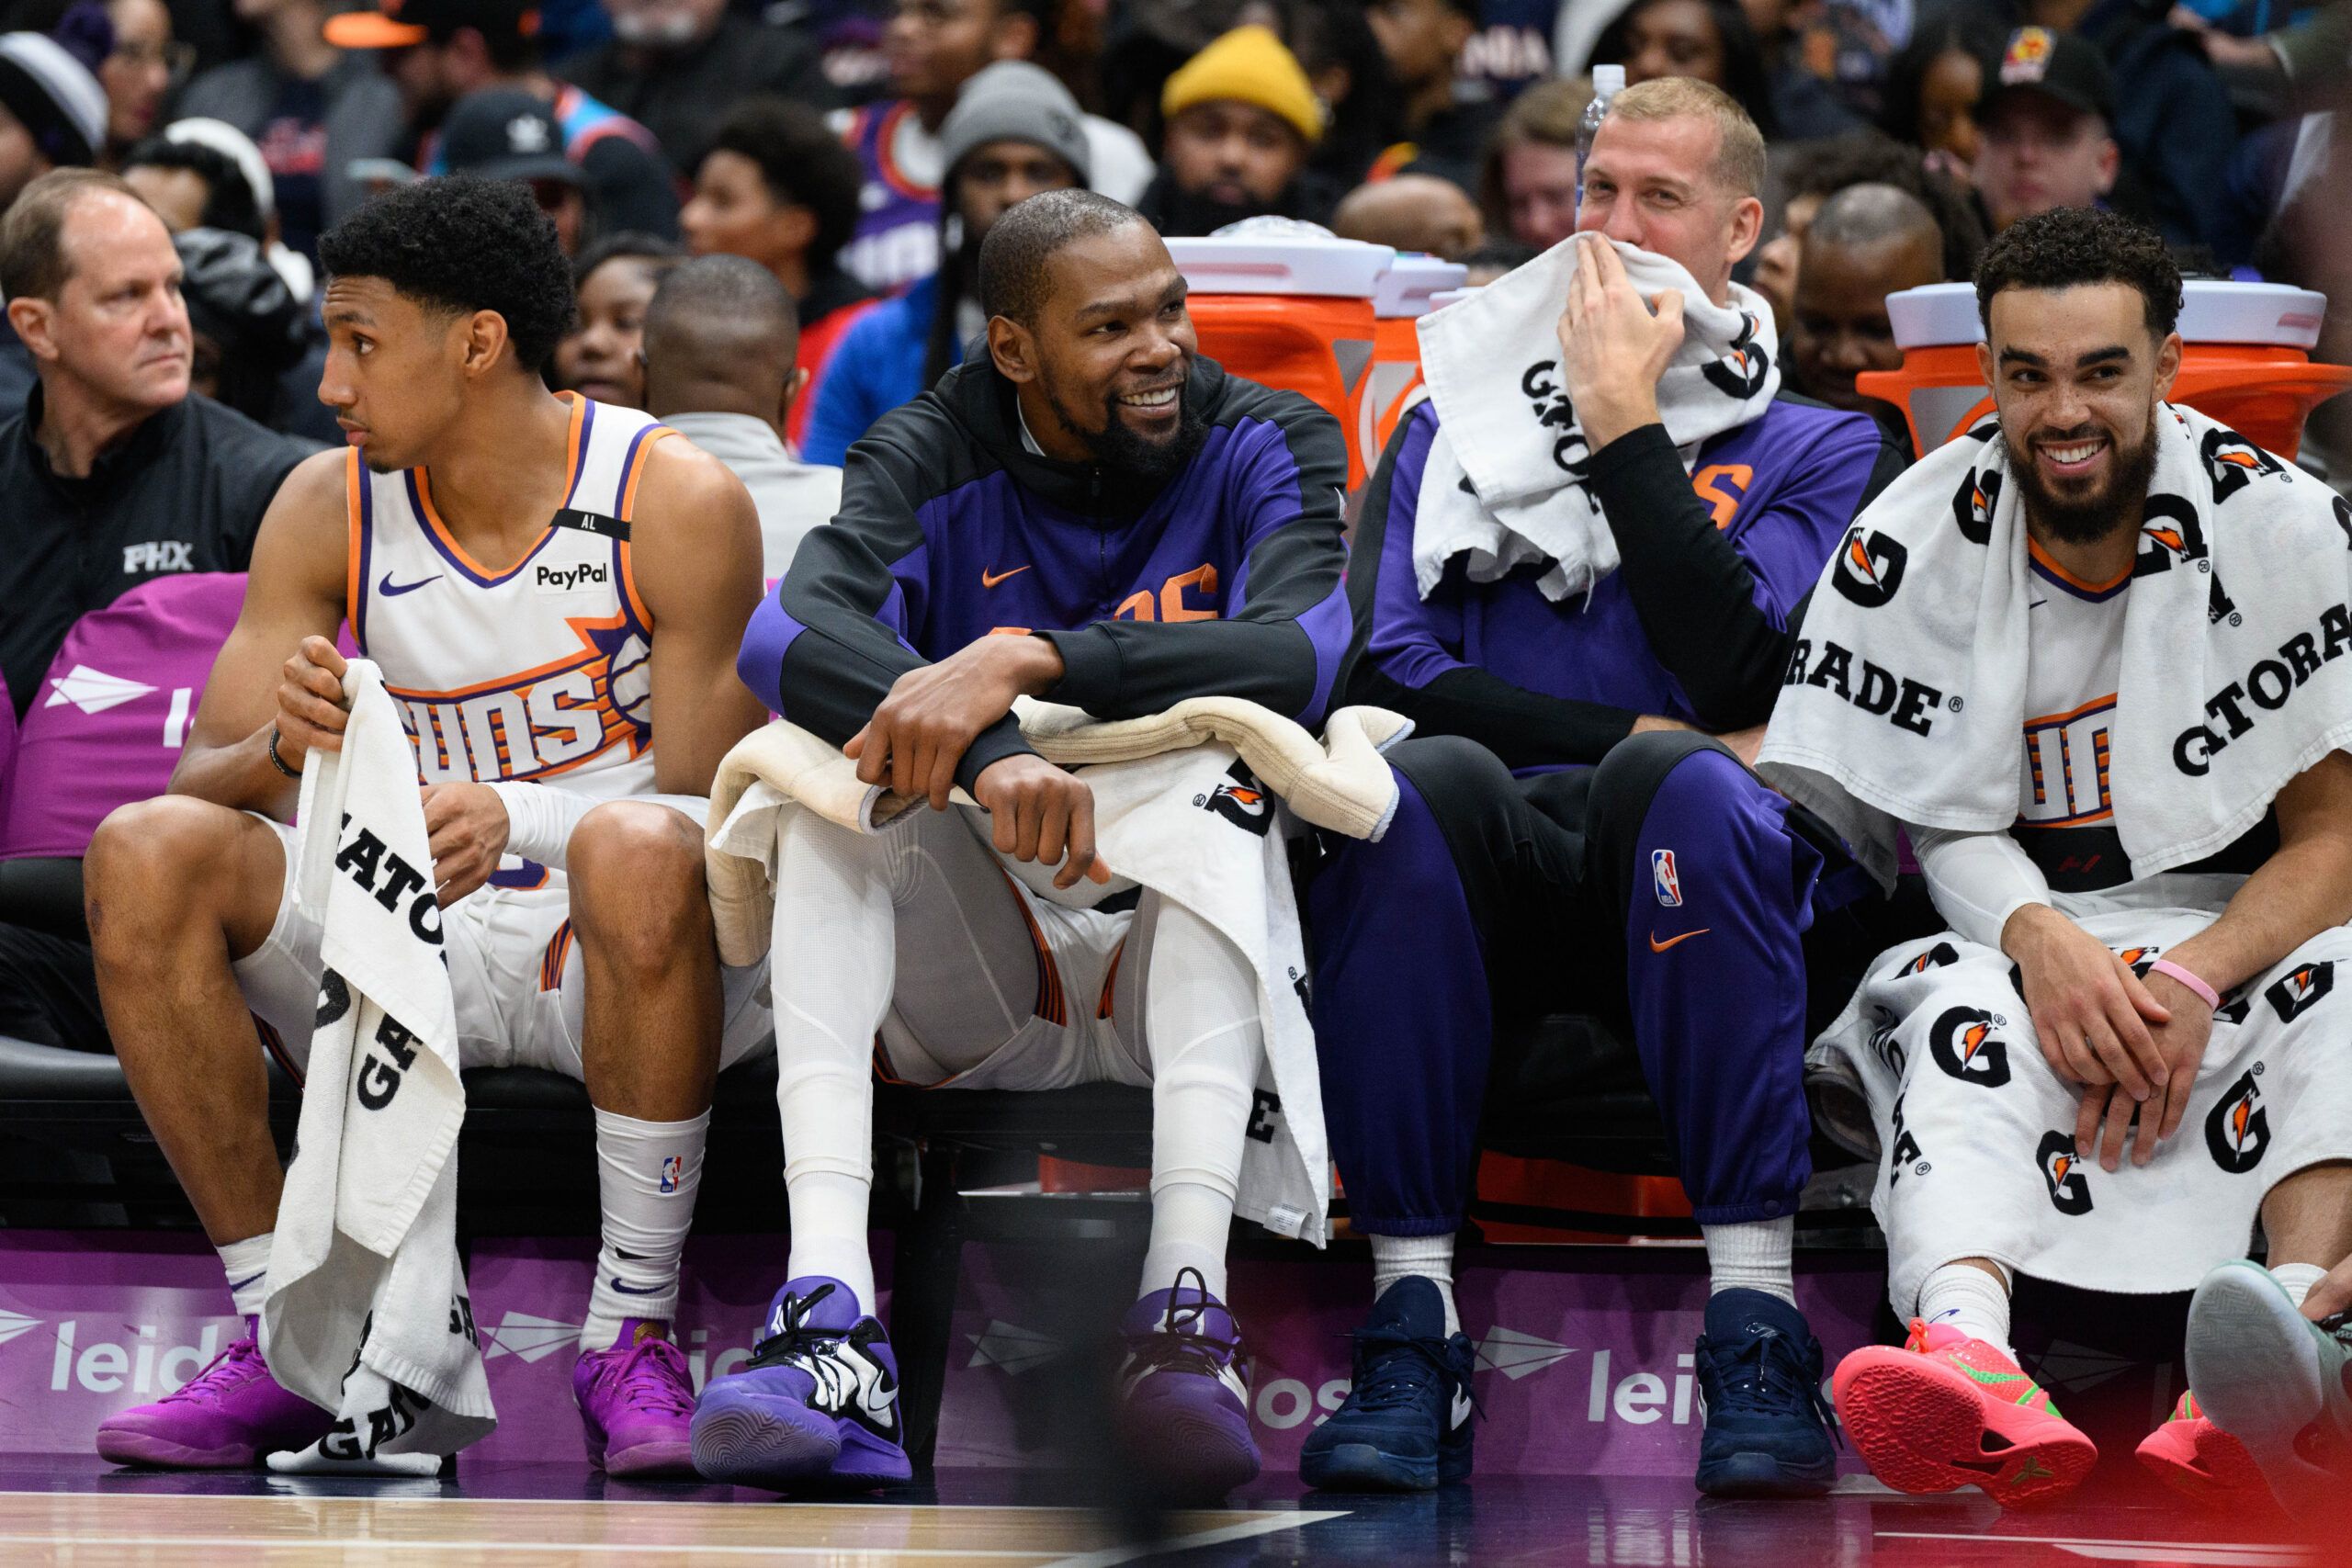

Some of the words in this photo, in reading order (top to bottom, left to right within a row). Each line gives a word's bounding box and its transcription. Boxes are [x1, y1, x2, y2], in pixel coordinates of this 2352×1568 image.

[581, 514, 595, 530] AL
[123, 540, 194, 573] PHX
[537, 562, 607, 591] PayPal
[1930, 1006, 2011, 1088] G
[2205, 1069, 2271, 1174] G
[1588, 1349, 1695, 1424] lei
